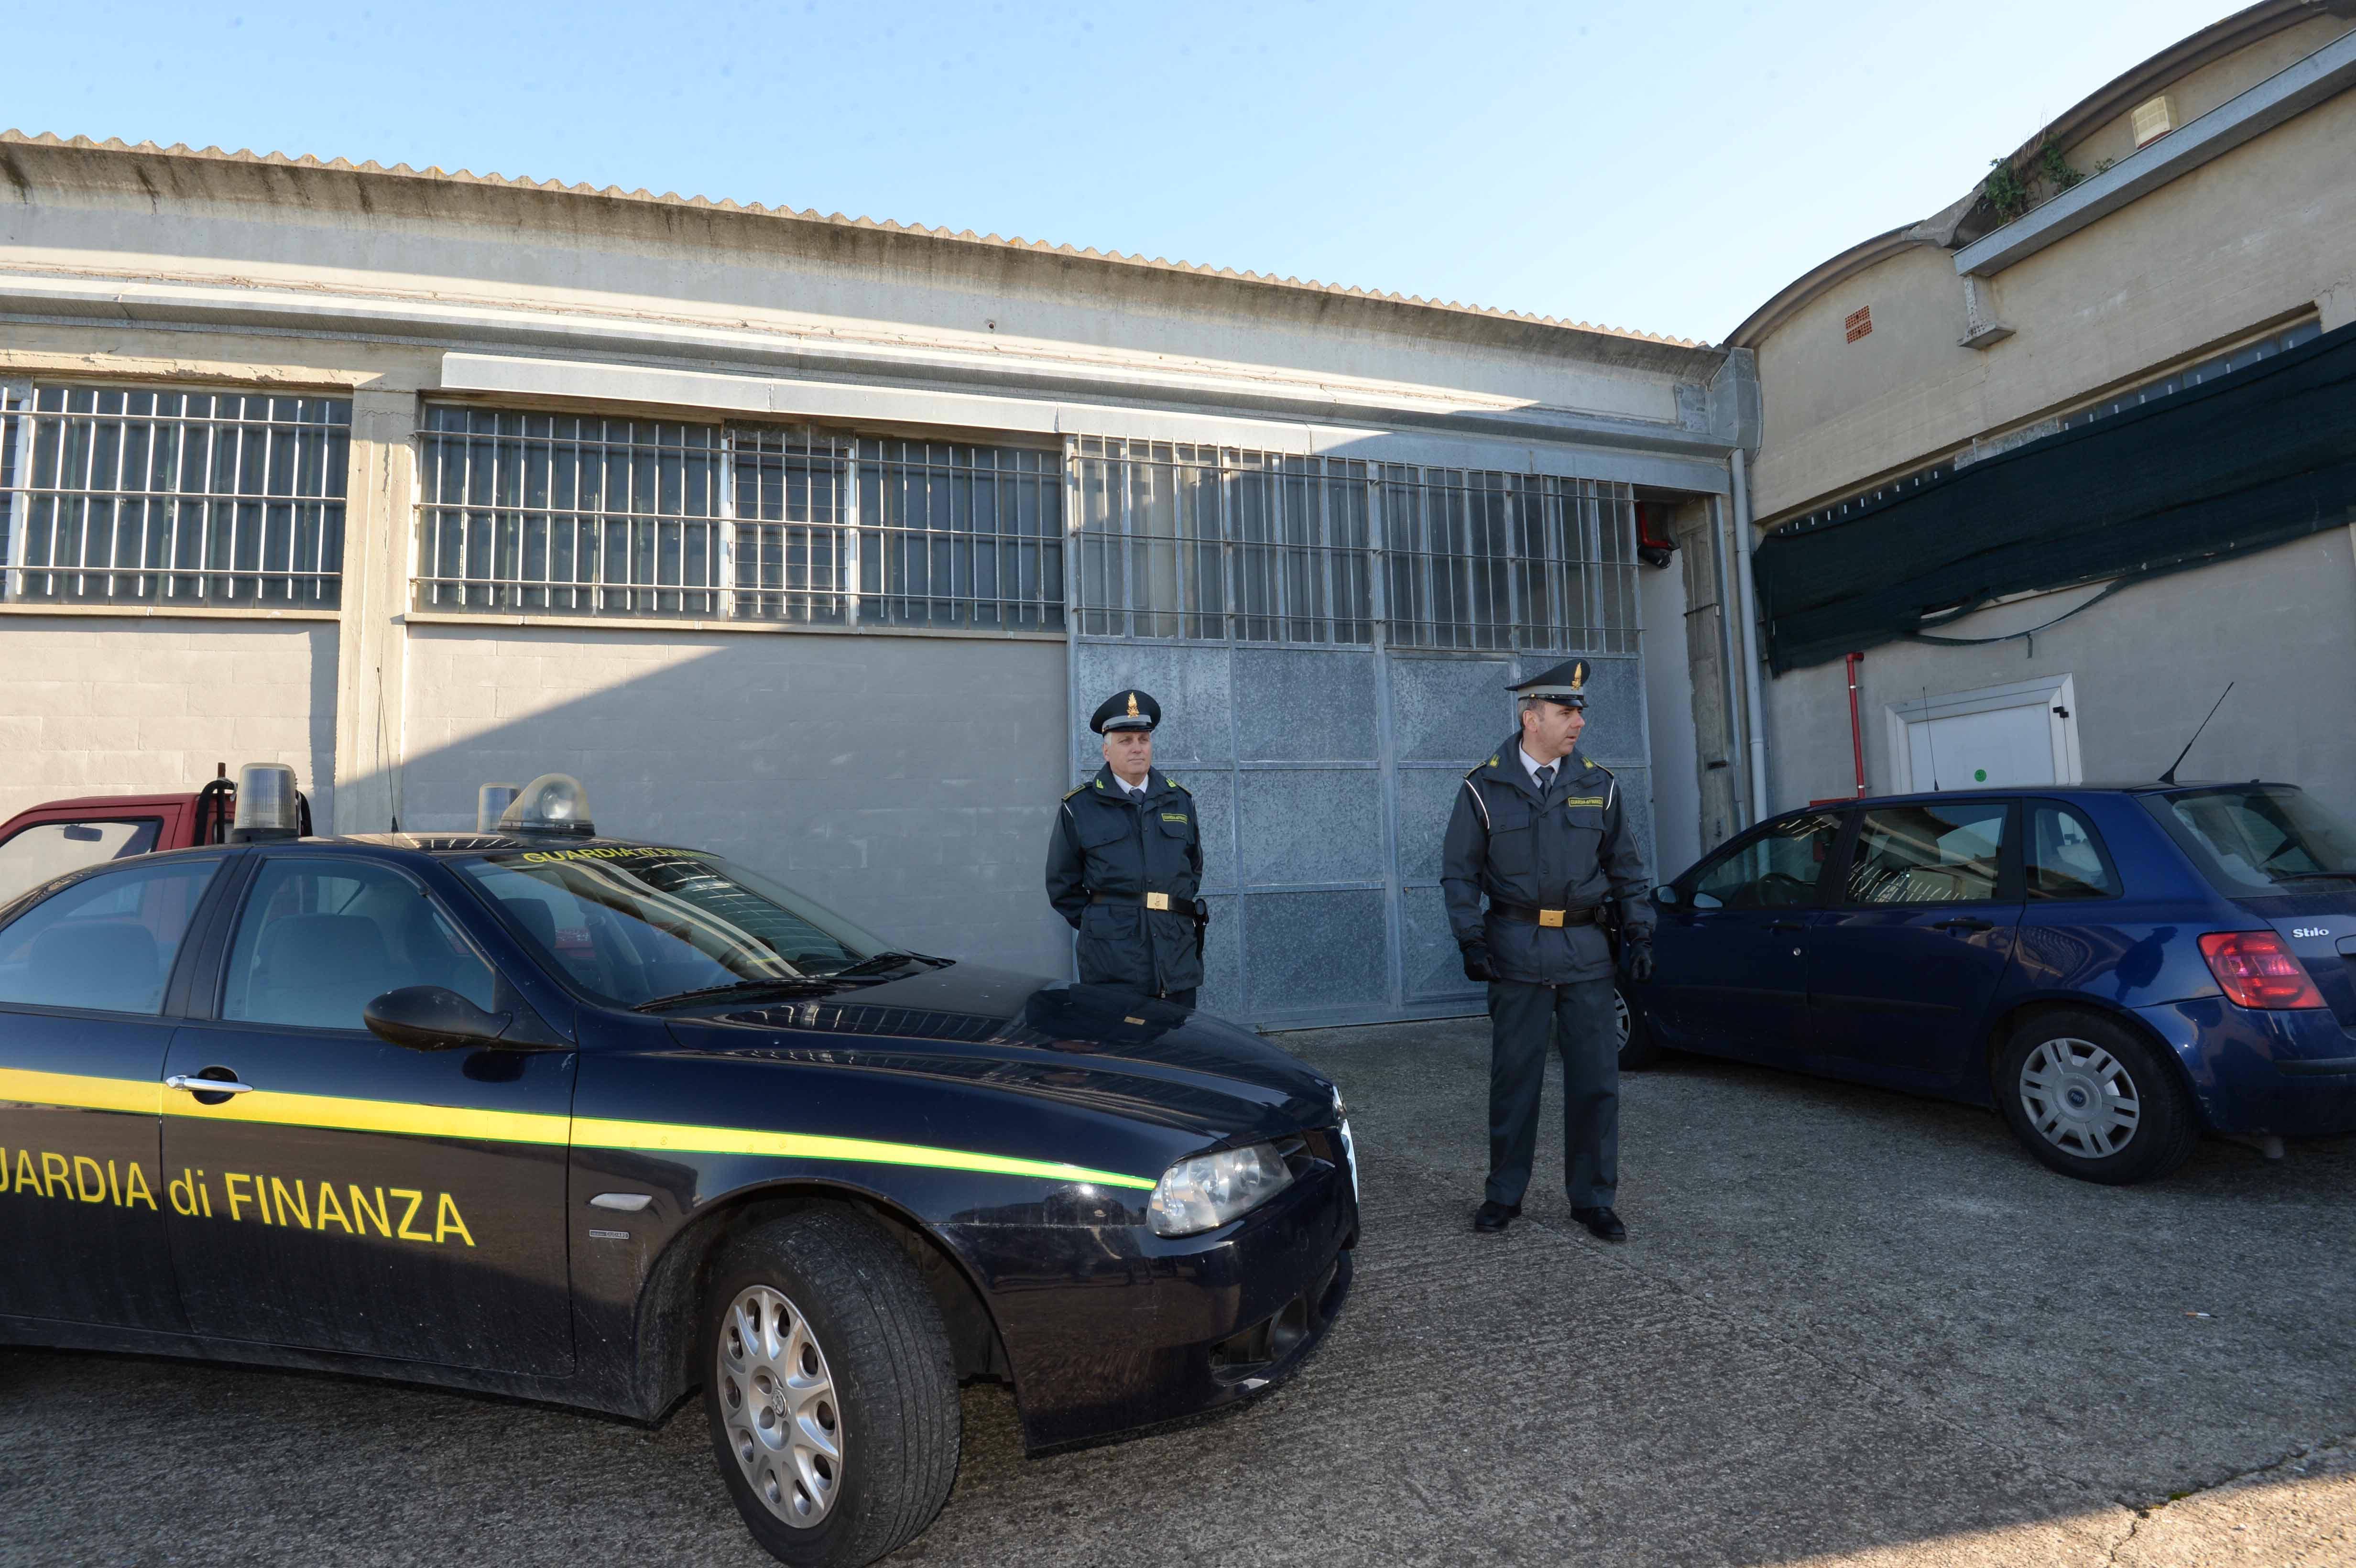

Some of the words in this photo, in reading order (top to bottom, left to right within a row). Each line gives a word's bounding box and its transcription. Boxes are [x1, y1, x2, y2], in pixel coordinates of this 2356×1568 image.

[523, 848, 640, 863] GUARDIA
[2292, 927, 2329, 938] Stilo
[169, 1168, 212, 1217] di
[225, 1172, 475, 1247] FINANZA
